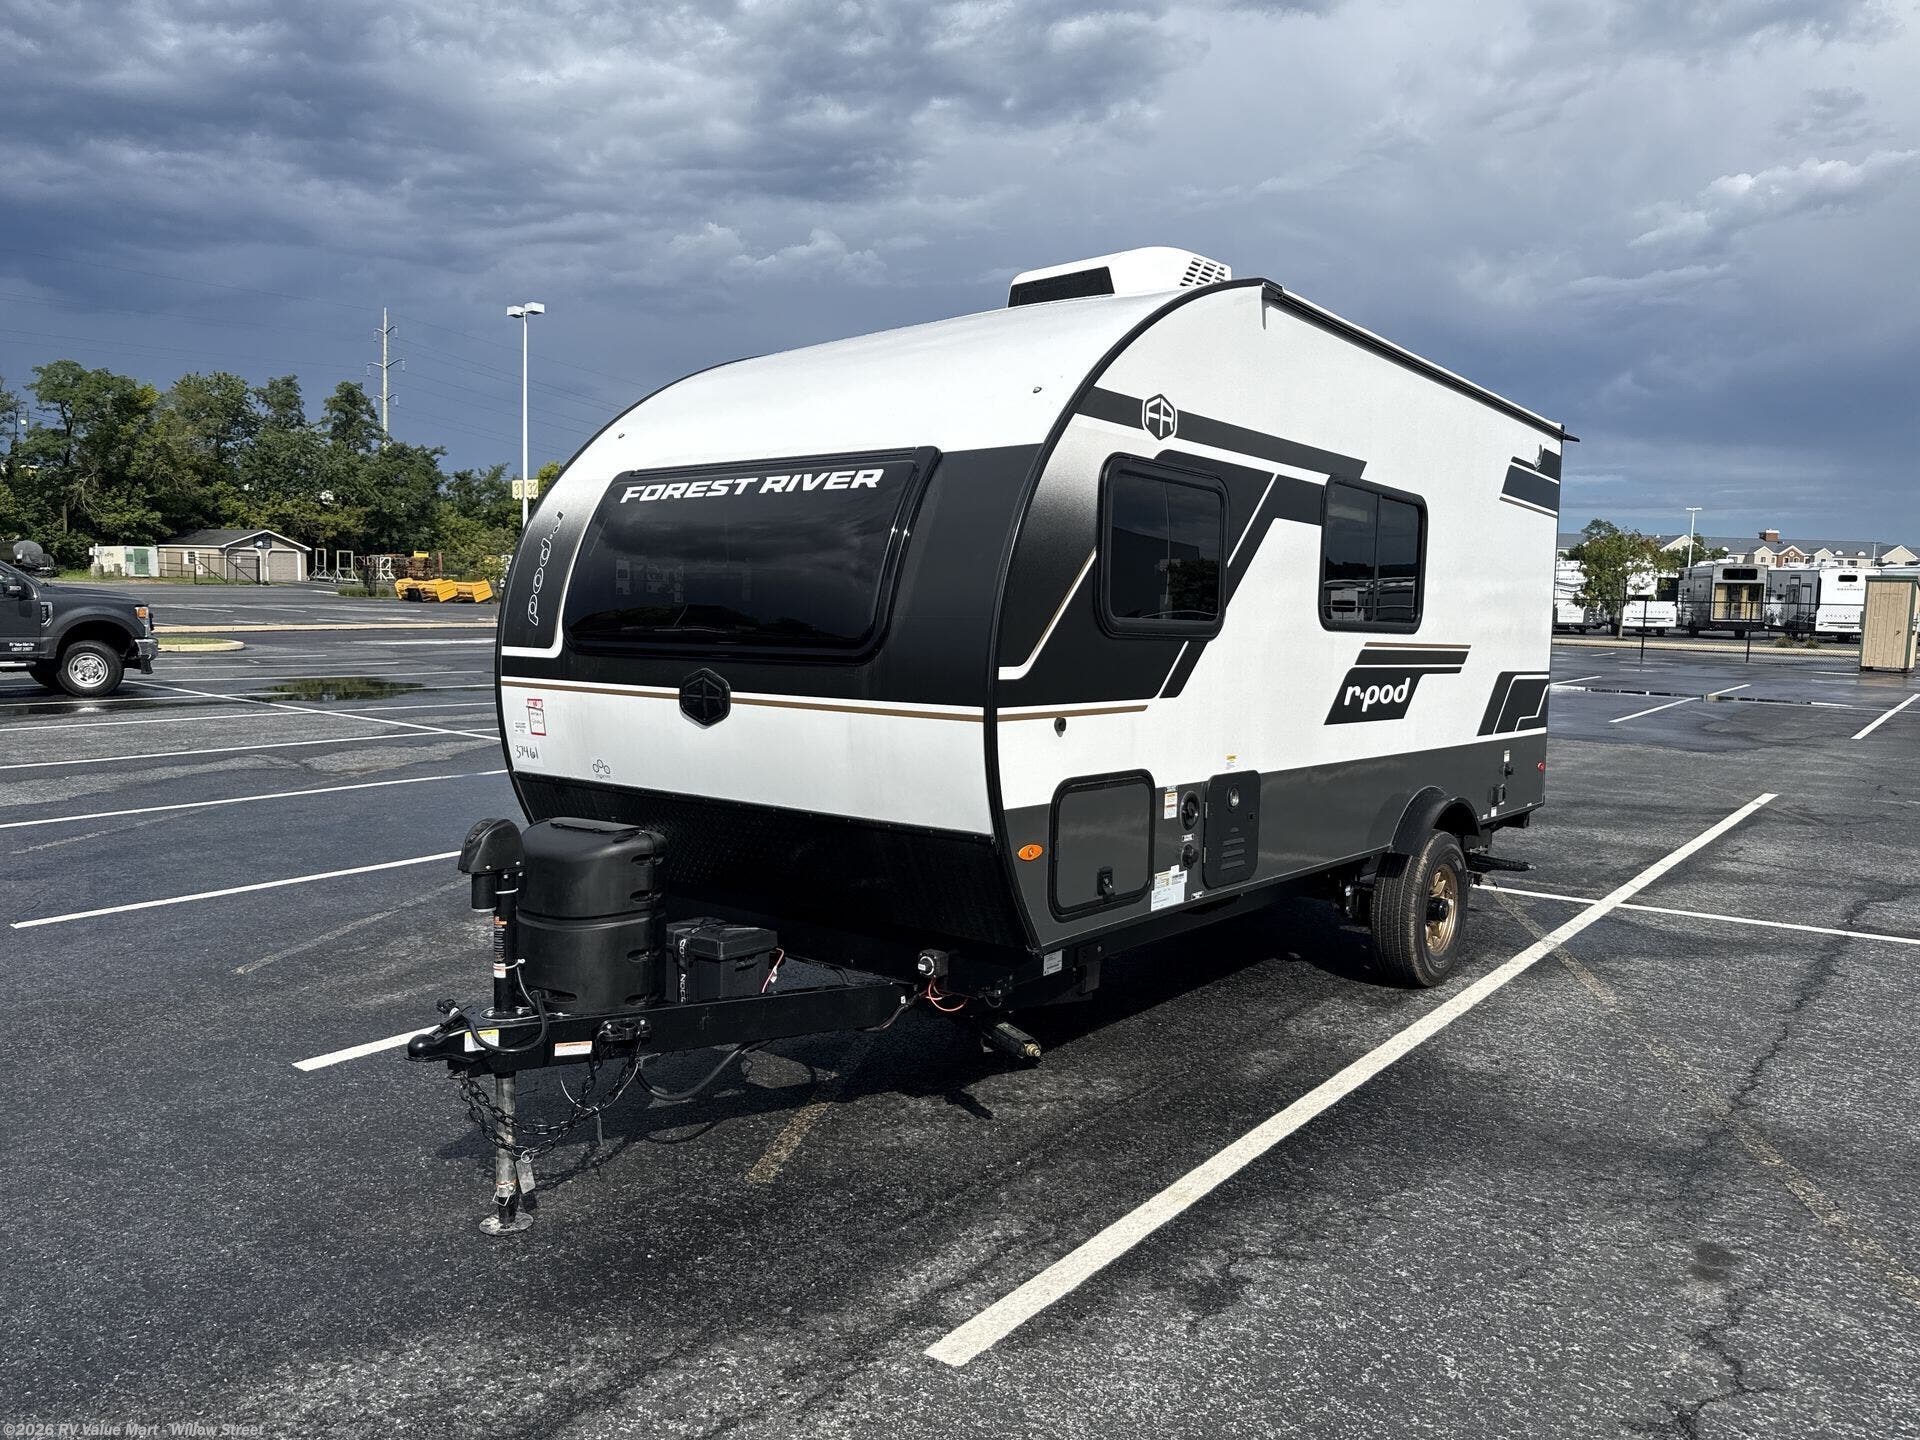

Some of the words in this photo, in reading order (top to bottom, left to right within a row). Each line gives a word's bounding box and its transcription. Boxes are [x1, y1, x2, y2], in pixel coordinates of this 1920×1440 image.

[527, 482, 538, 496] 32
[619, 477, 759, 504] FOREST
[758, 468, 885, 494] RIVER
[515, 744, 539, 760] 37461
